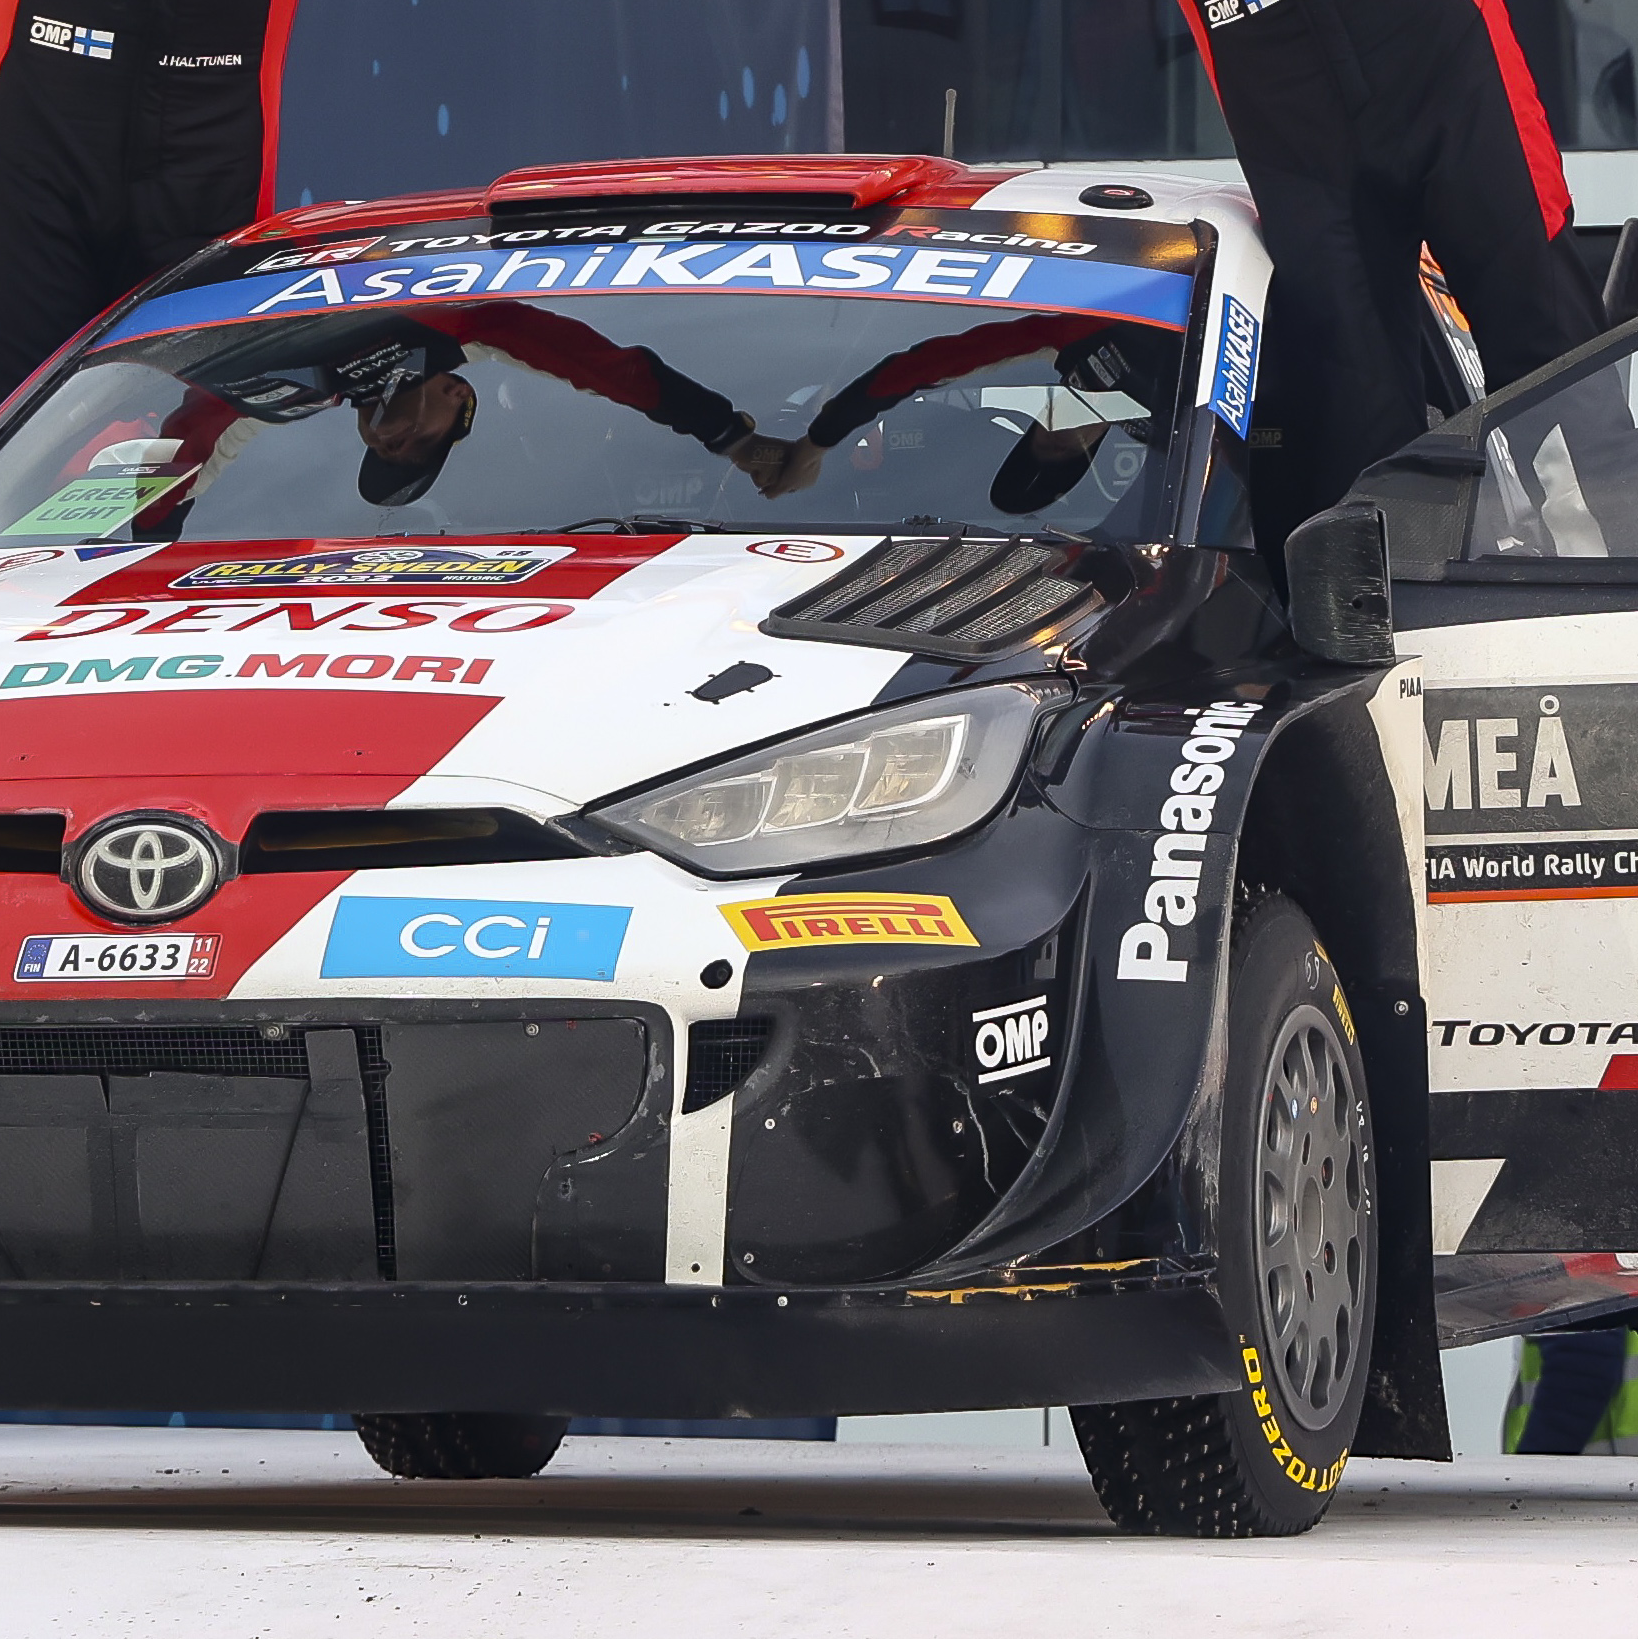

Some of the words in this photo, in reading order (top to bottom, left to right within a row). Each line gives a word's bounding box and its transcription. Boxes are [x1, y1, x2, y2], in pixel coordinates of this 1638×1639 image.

[30, 21, 72, 45] OMP
[260, 242, 365, 271] GR
[387, 224, 625, 253] TOYOTA
[641, 220, 872, 238] GAZOO
[883, 223, 1099, 256] Racing
[247, 243, 1036, 315] AsahiKASEI
[1216, 299, 1255, 432] AsahiKASEI
[57, 485, 157, 502] GREEN
[36, 505, 126, 522] LIGHT
[203, 562, 343, 577] RALLY
[344, 559, 535, 575] SWEDEN
[296, 574, 391, 583] 2022
[15, 601, 577, 644] DENSO
[234, 653, 496, 685] MORI
[1399, 676, 1423, 700] PIAA
[1423, 694, 1582, 811] MEÅ
[1116, 698, 1264, 984] Panasonic
[1462, 853, 1535, 879] World
[1544, 853, 1606, 878] Rally
[399, 913, 552, 960] CCi
[742, 901, 954, 942] PIRELLI
[23, 962, 42, 974] FIN
[188, 958, 209, 974] 22
[58, 941, 180, 973] A-6633
[194, 938, 212, 953] 11
[974, 1007, 1052, 1068] OMP
